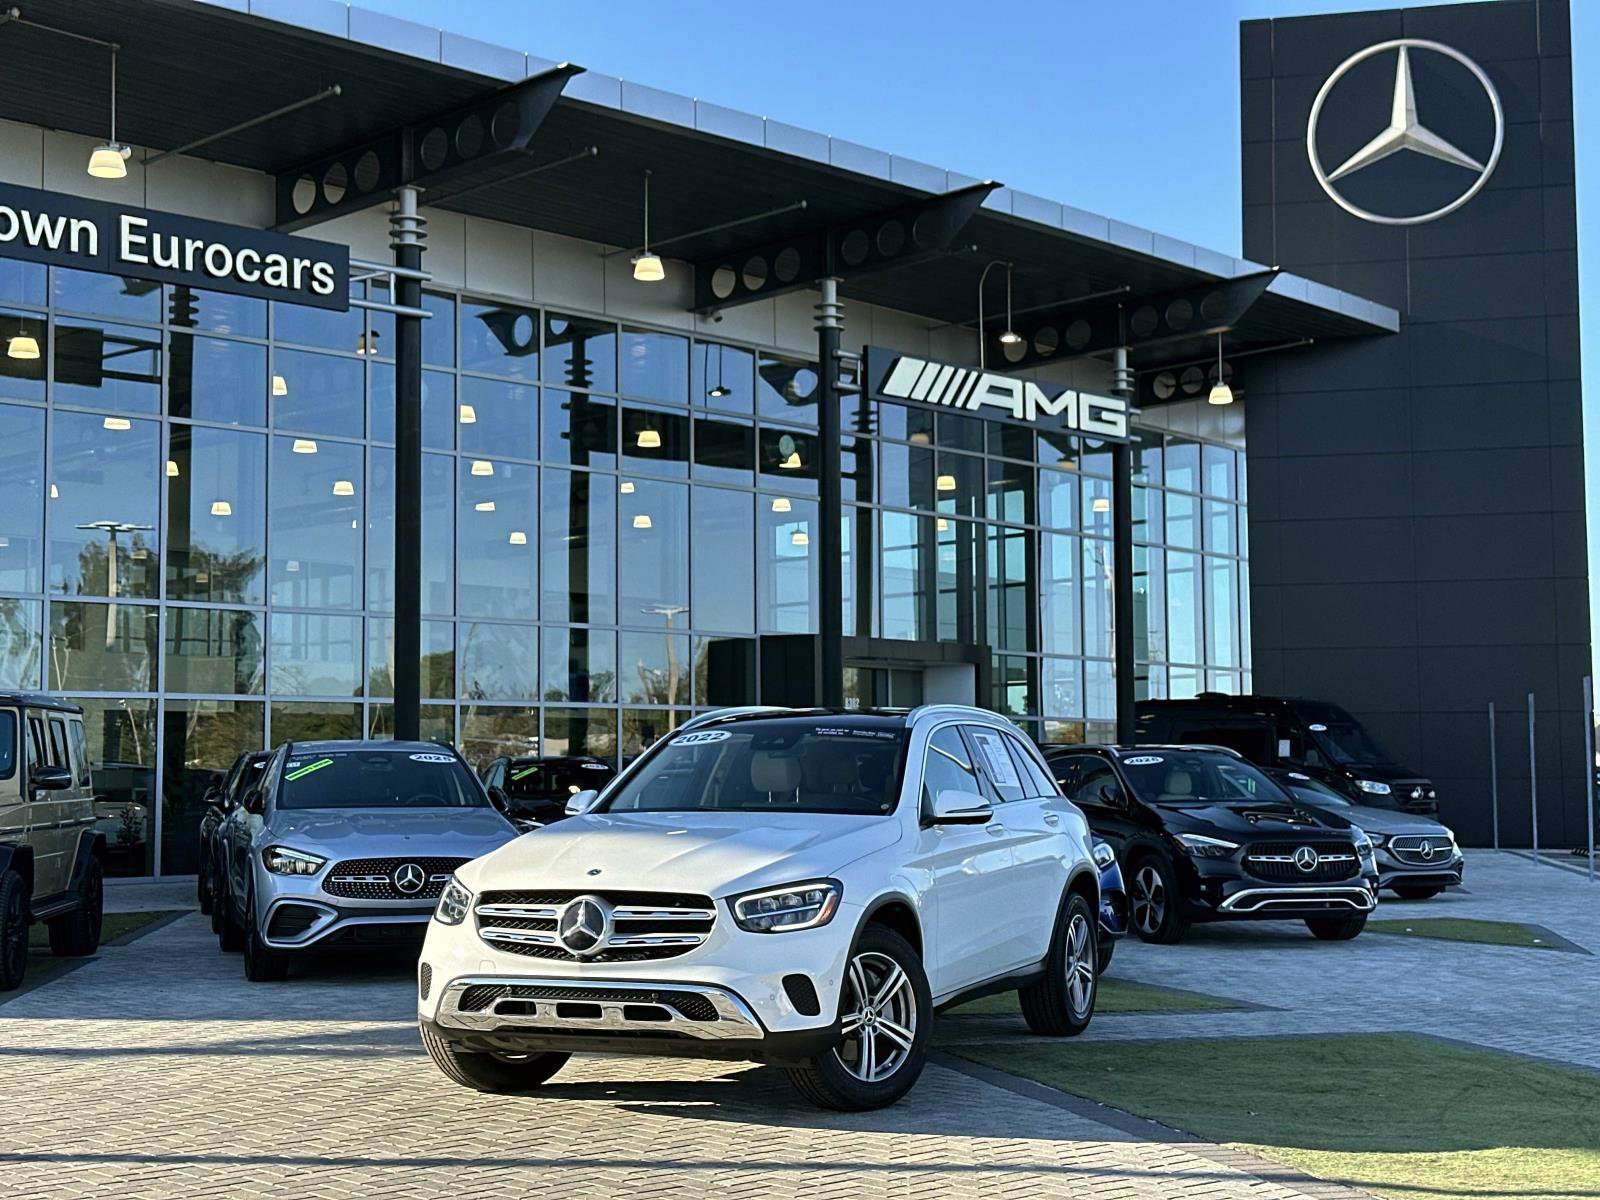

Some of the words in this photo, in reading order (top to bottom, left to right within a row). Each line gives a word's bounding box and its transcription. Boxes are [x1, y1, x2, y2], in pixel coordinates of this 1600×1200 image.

[120, 214, 335, 295] Eurocars
[966, 372, 1127, 438] AMG
[673, 732, 725, 745] 2022
